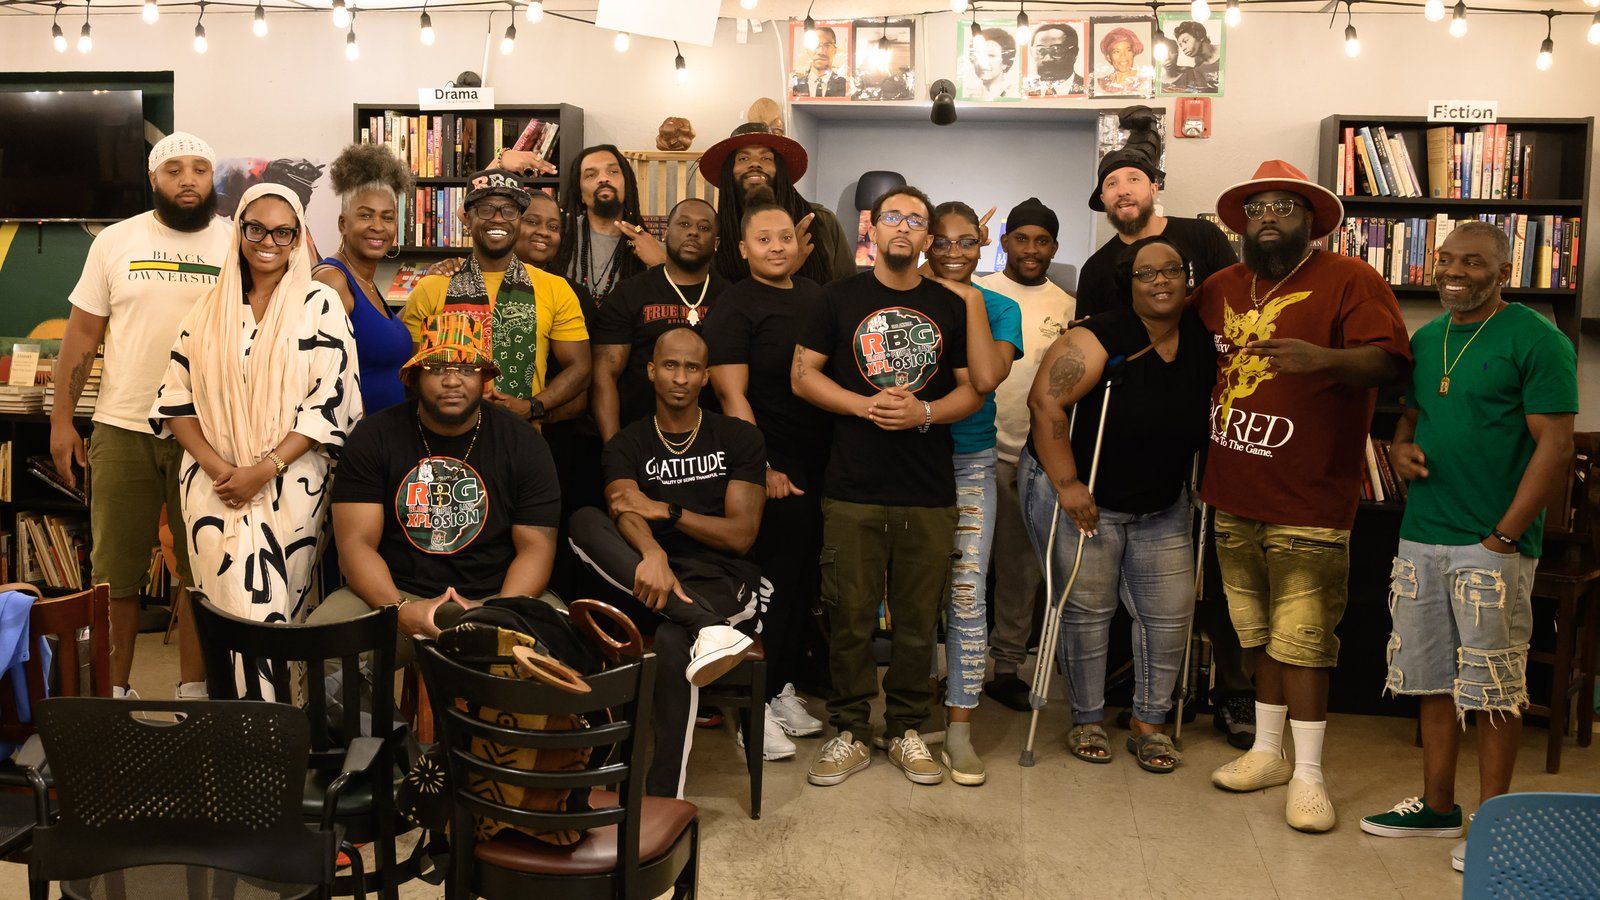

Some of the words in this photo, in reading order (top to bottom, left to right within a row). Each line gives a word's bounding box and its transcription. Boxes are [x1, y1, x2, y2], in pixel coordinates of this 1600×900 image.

[434, 88, 479, 100] Drama
[1433, 104, 1493, 119] Fiction
[1225, 233, 1239, 242] IRE
[153, 250, 205, 263] BLACK
[128, 271, 218, 285] OWNERSHI
[643, 305, 679, 324] TRUE
[860, 323, 935, 357] RBG
[866, 351, 937, 377] XPLOSION
[1220, 436, 1228, 447] To
[1228, 439, 1245, 451] The
[1245, 443, 1273, 458] Game.
[696, 473, 719, 481] THANKFUL
[406, 478, 478, 506] RBG
[406, 509, 480, 529] XPLOSION
